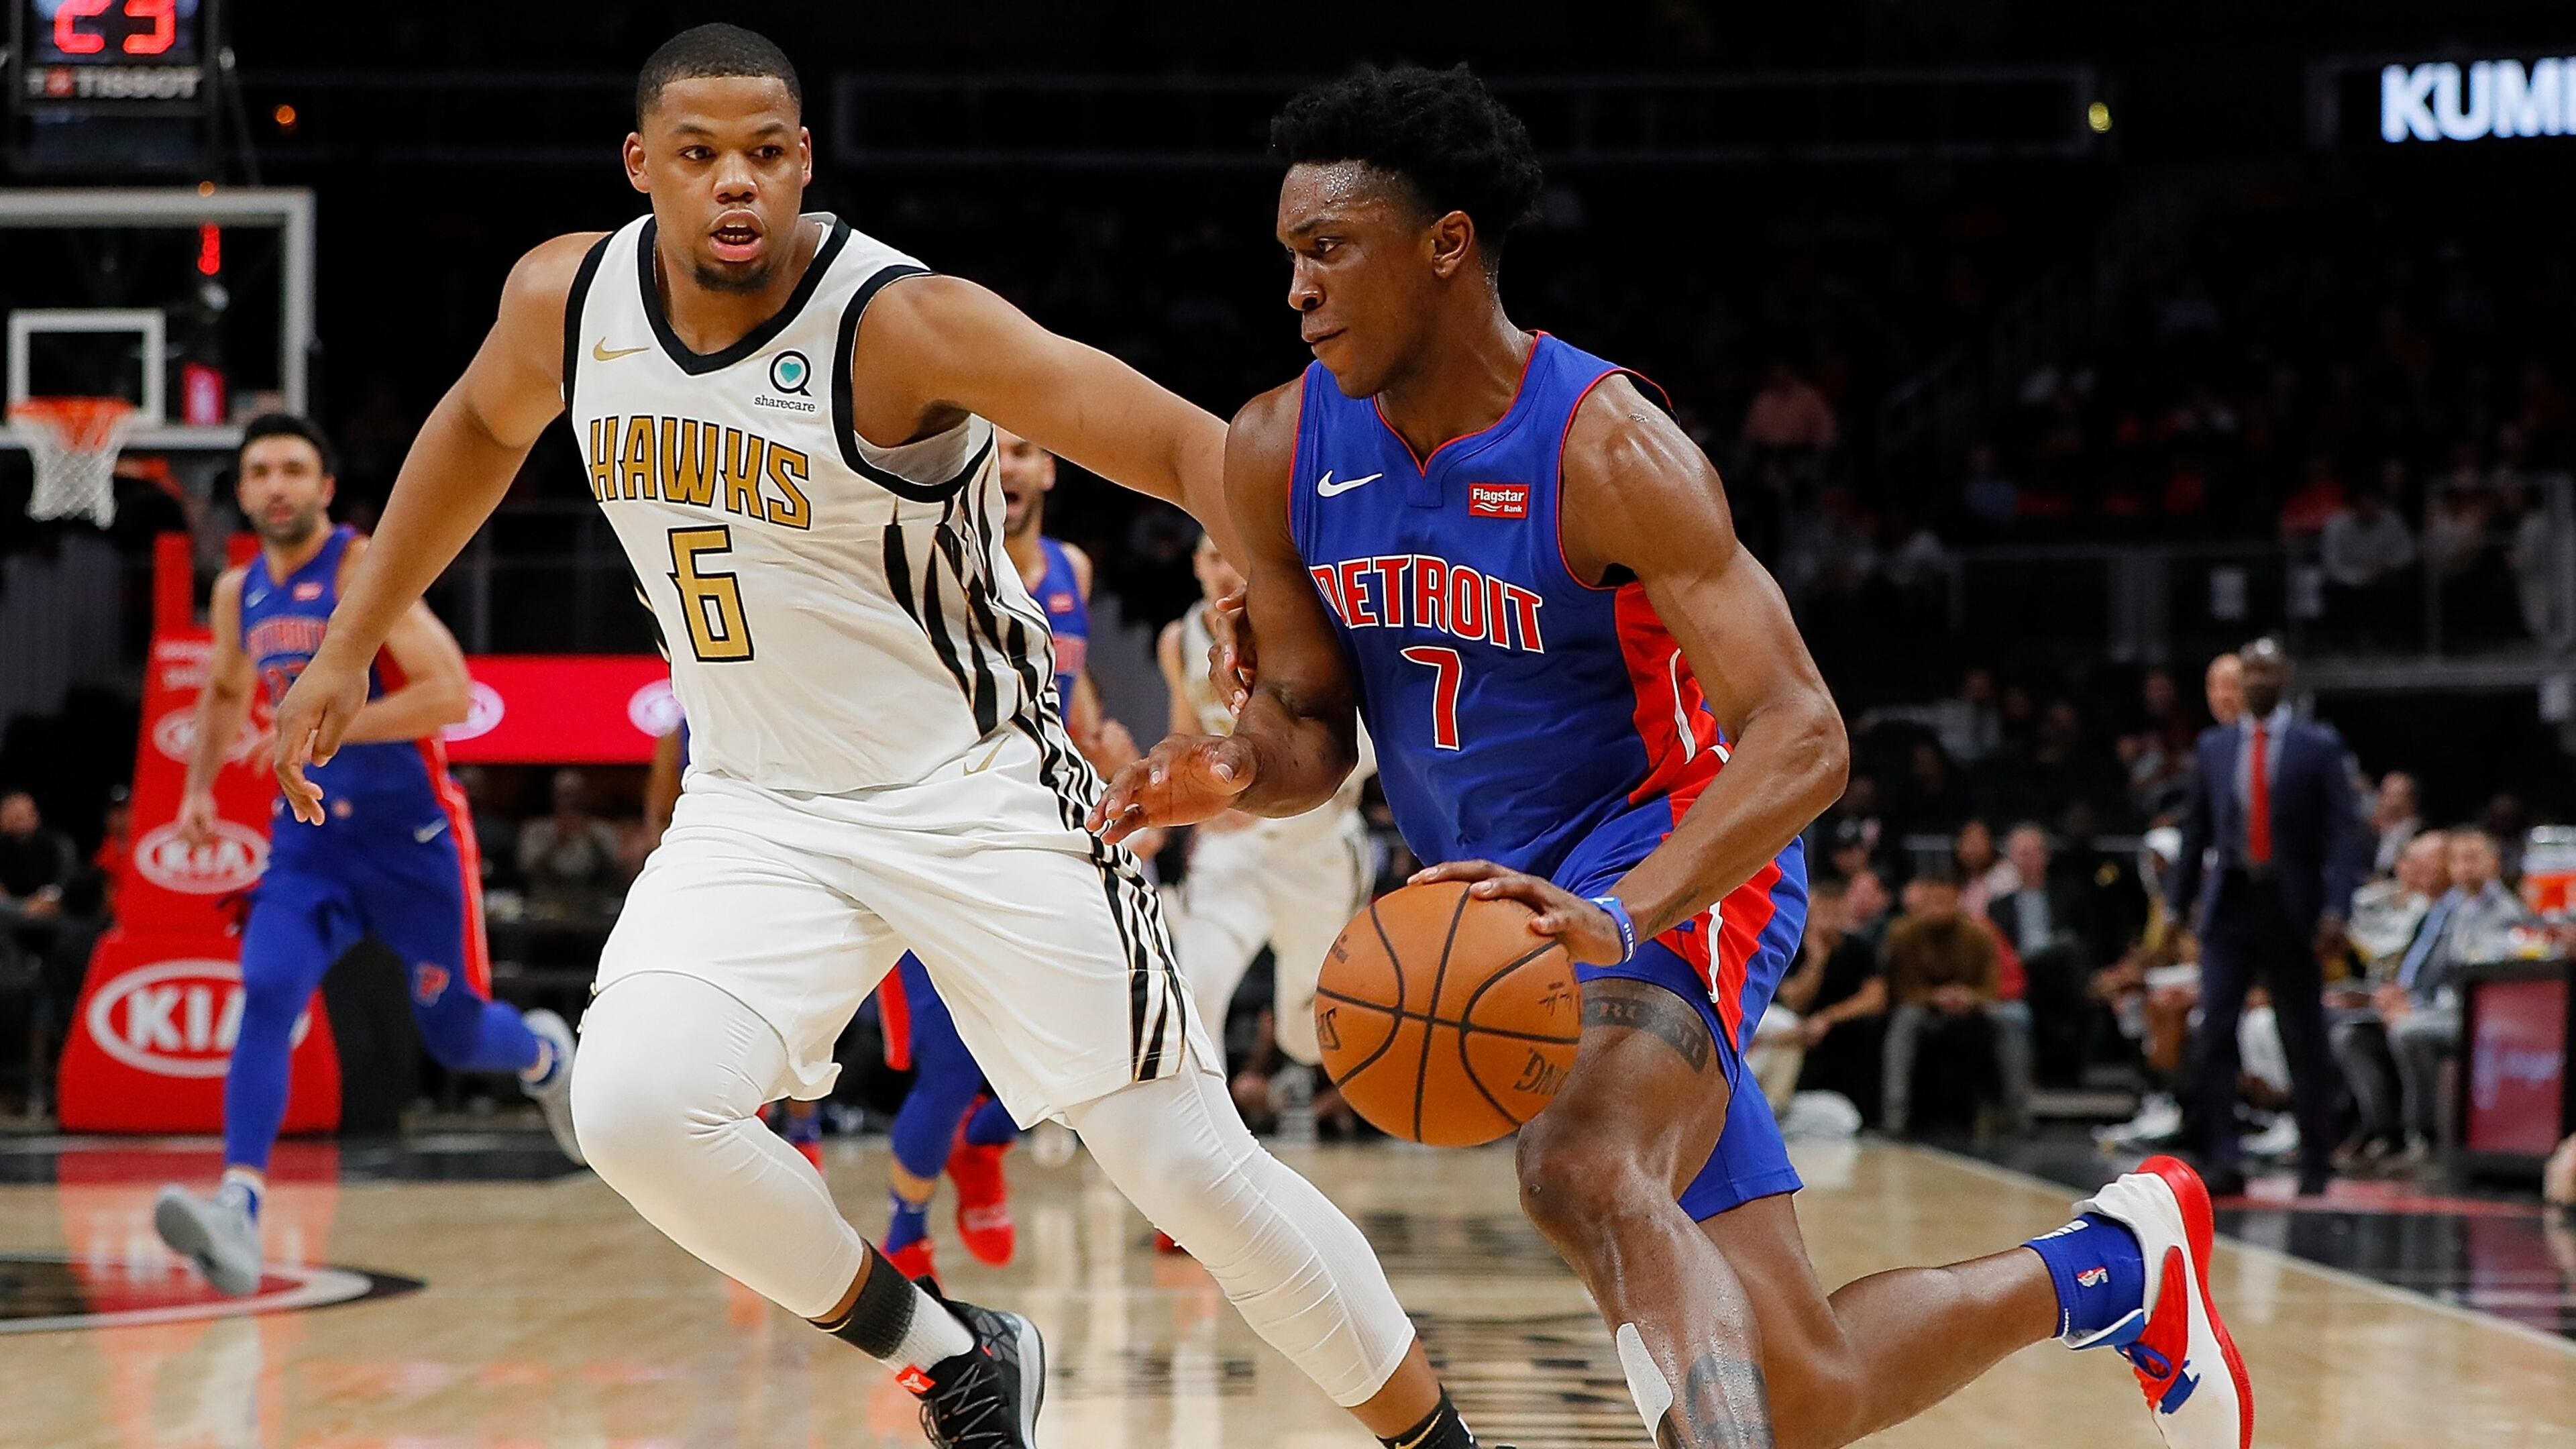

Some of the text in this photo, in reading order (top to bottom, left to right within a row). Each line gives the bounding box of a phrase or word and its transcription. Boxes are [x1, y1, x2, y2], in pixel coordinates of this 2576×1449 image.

[754, 394, 816, 413] sharecare
[589, 415, 810, 531] HAWKS
[1472, 488, 1525, 504] Flagstar
[1504, 504, 1522, 513] Bank
[667, 524, 755, 663] 6
[1309, 554, 1544, 653] DETROIT
[1400, 645, 1462, 751] 7
